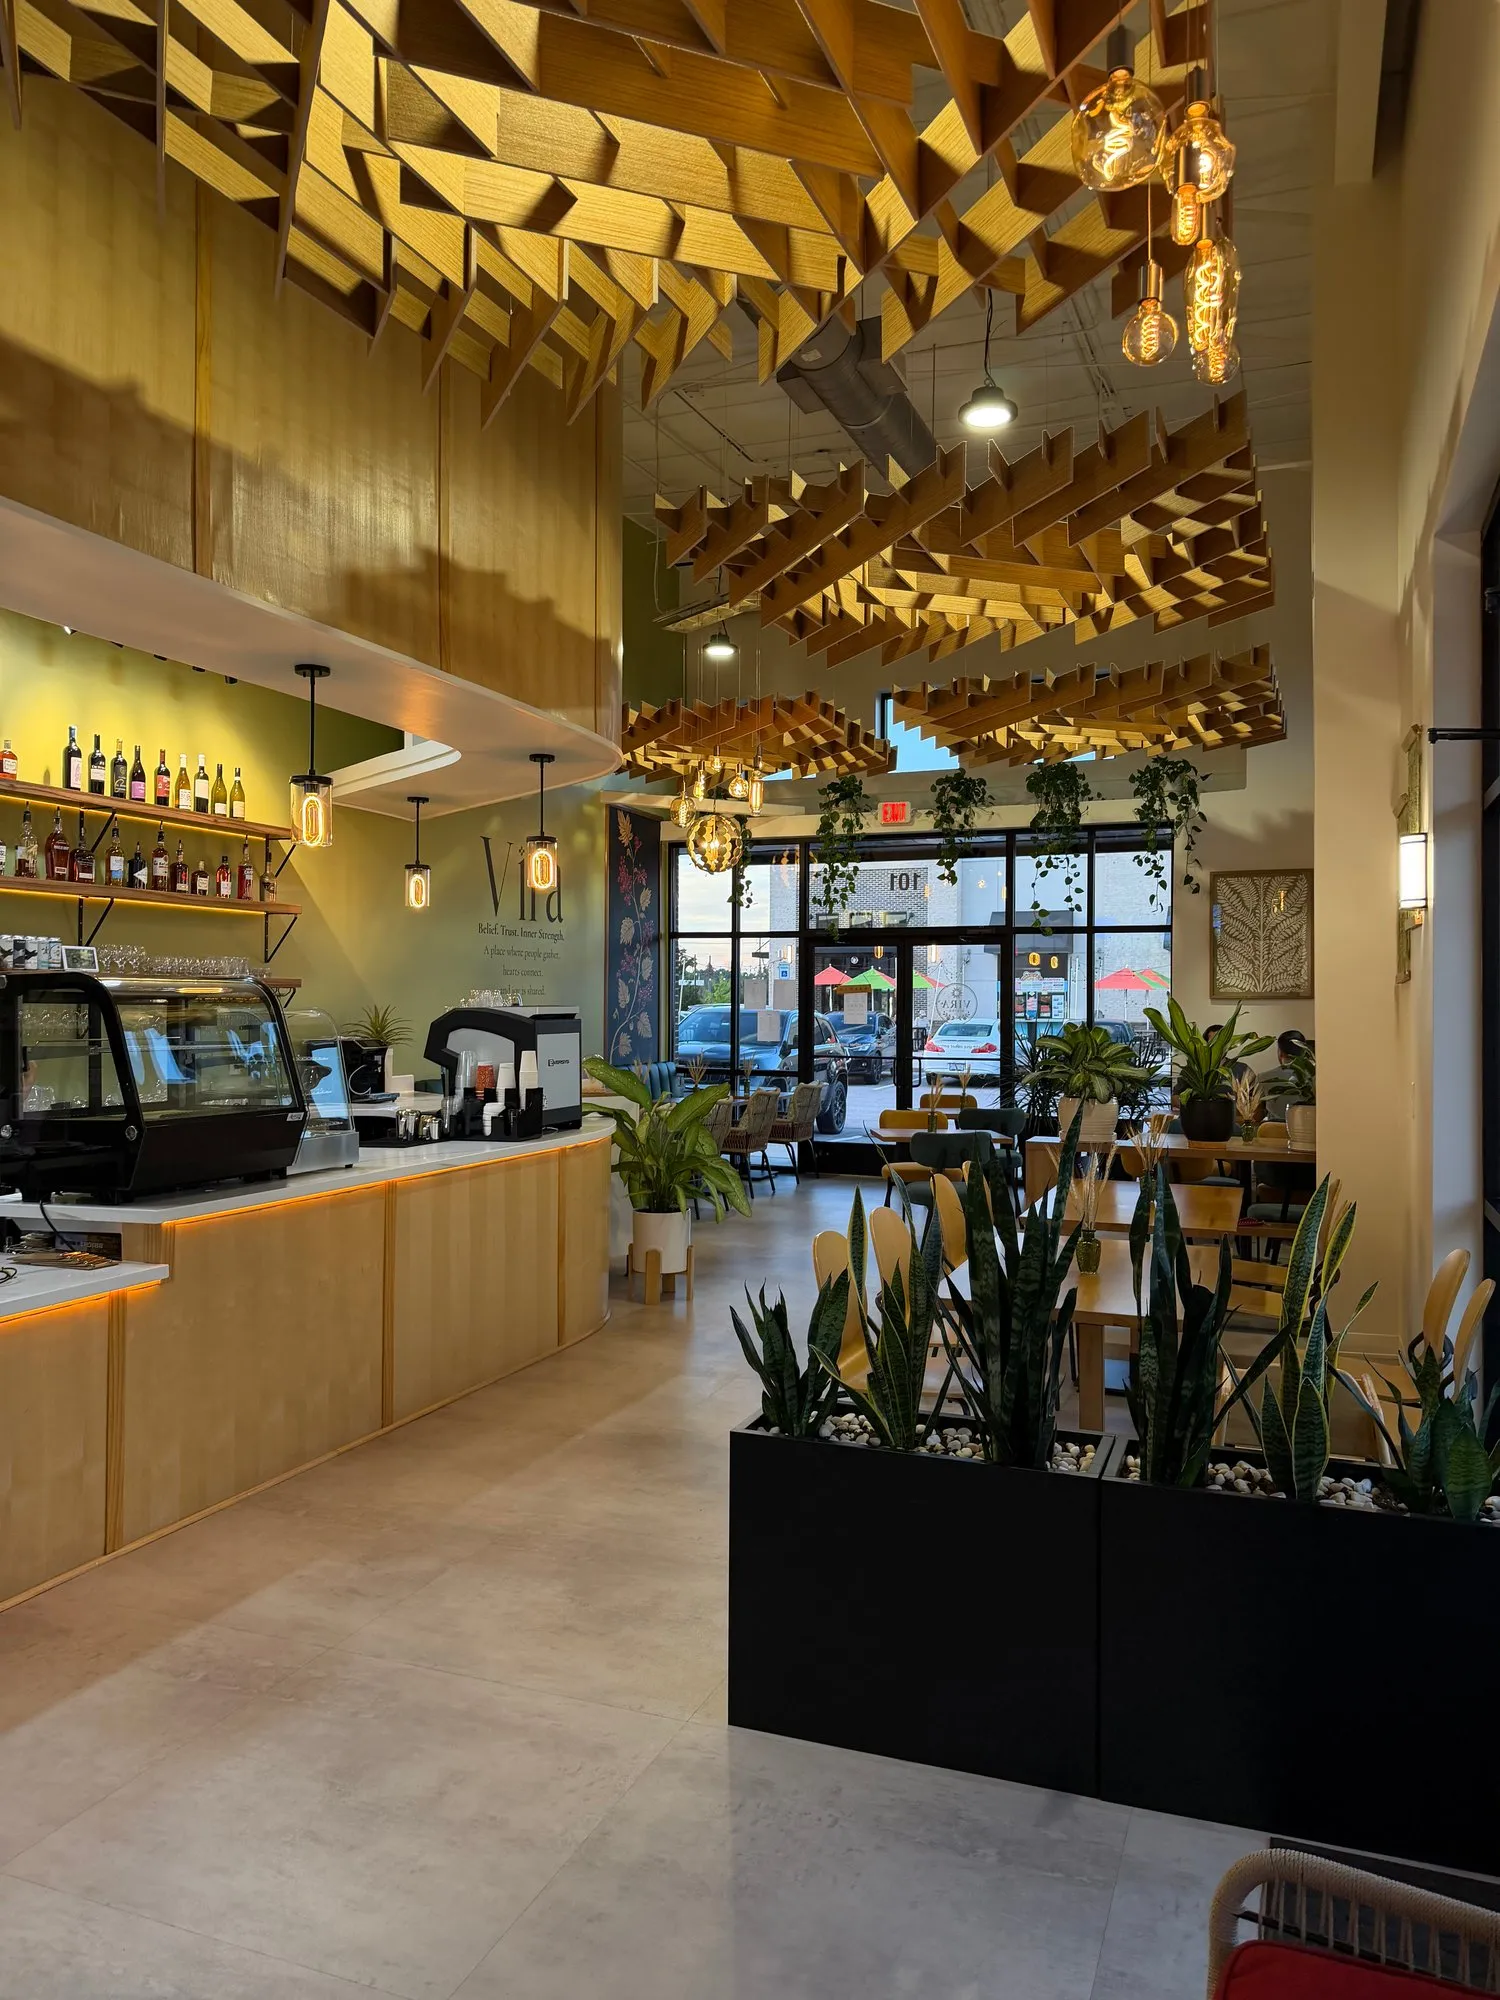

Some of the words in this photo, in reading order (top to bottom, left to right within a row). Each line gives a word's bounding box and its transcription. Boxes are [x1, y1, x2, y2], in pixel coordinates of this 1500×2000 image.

[478, 923, 498, 935] Belief.
[500, 926, 519, 937] Trust.
[521, 927, 537, 938] Inner
[538, 929, 564, 944] Strength.
[484, 945, 489, 955] A
[490, 945, 505, 958] place
[506, 946, 524, 957] where
[524, 949, 542, 960] people
[503, 965, 520, 976] hearts
